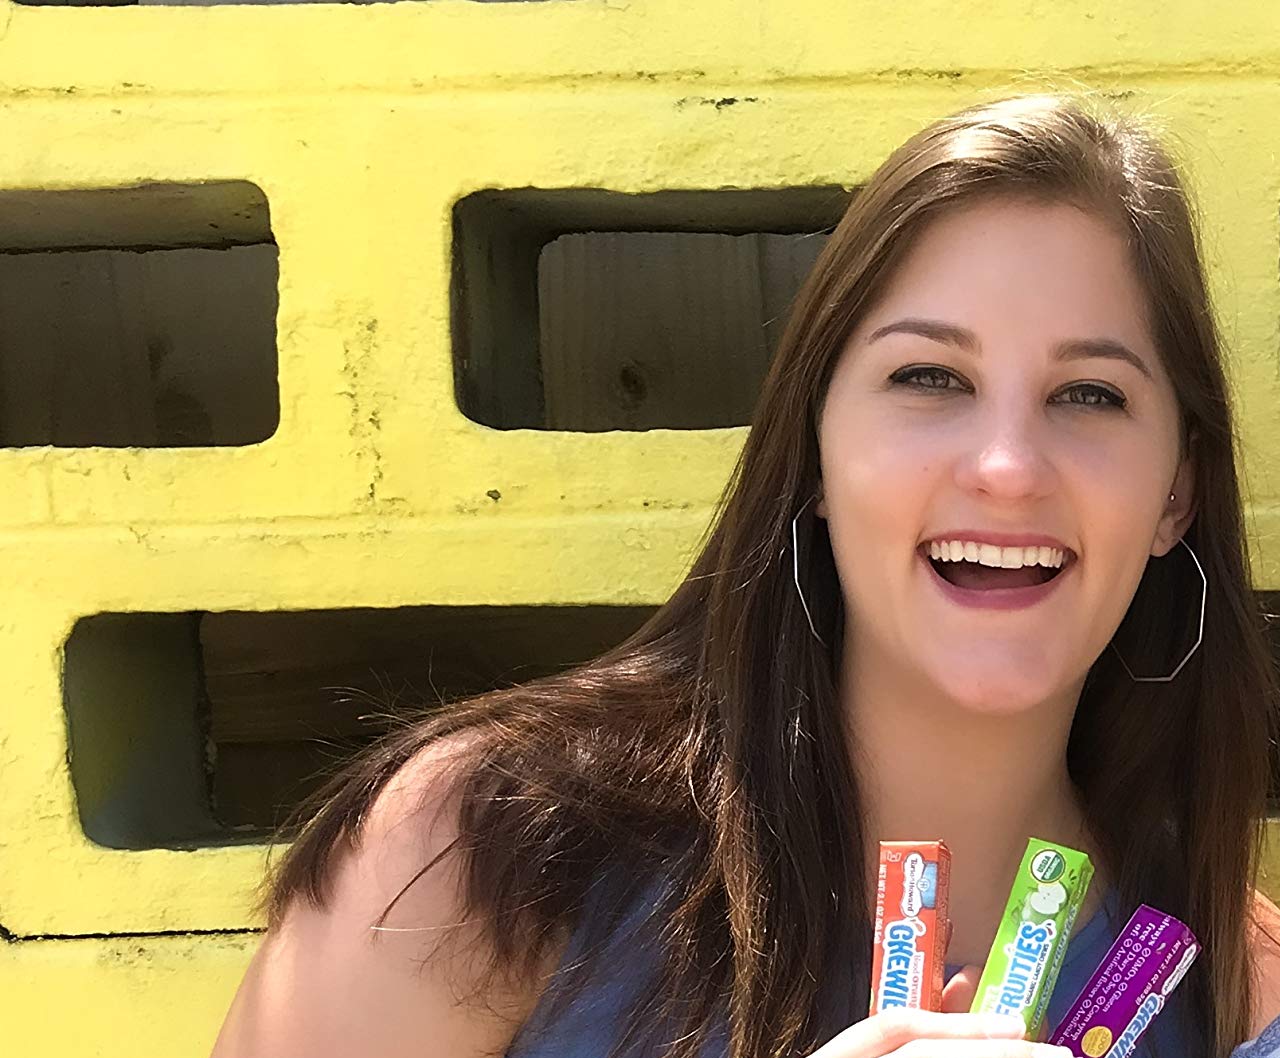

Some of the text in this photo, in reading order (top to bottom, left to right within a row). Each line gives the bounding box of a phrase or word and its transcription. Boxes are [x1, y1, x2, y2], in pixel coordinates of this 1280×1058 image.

[1035, 853, 1052, 873] USDA
[1137, 921, 1155, 942] free
[1146, 915, 1173, 947] always
[1169, 939, 1182, 953] NET
[1102, 946, 1126, 977] Artificial
[1114, 950, 1135, 972] Dairy
[1162, 951, 1173, 964] WT
[993, 921, 1047, 1020] FRUITIES
[1023, 942, 1050, 1005] ORGANIC CANDY CHEWS
[1149, 972, 1159, 984] OZ
[908, 975, 919, 1008] orang
[1087, 975, 1108, 999] flavors
[1100, 980, 1116, 995] Soy
[1083, 1003, 1100, 1022] Corn
[1101, 989, 1123, 1014] Gluten
[1062, 1006, 1086, 1037] Artificial
[1067, 1020, 1086, 1041] syrup
